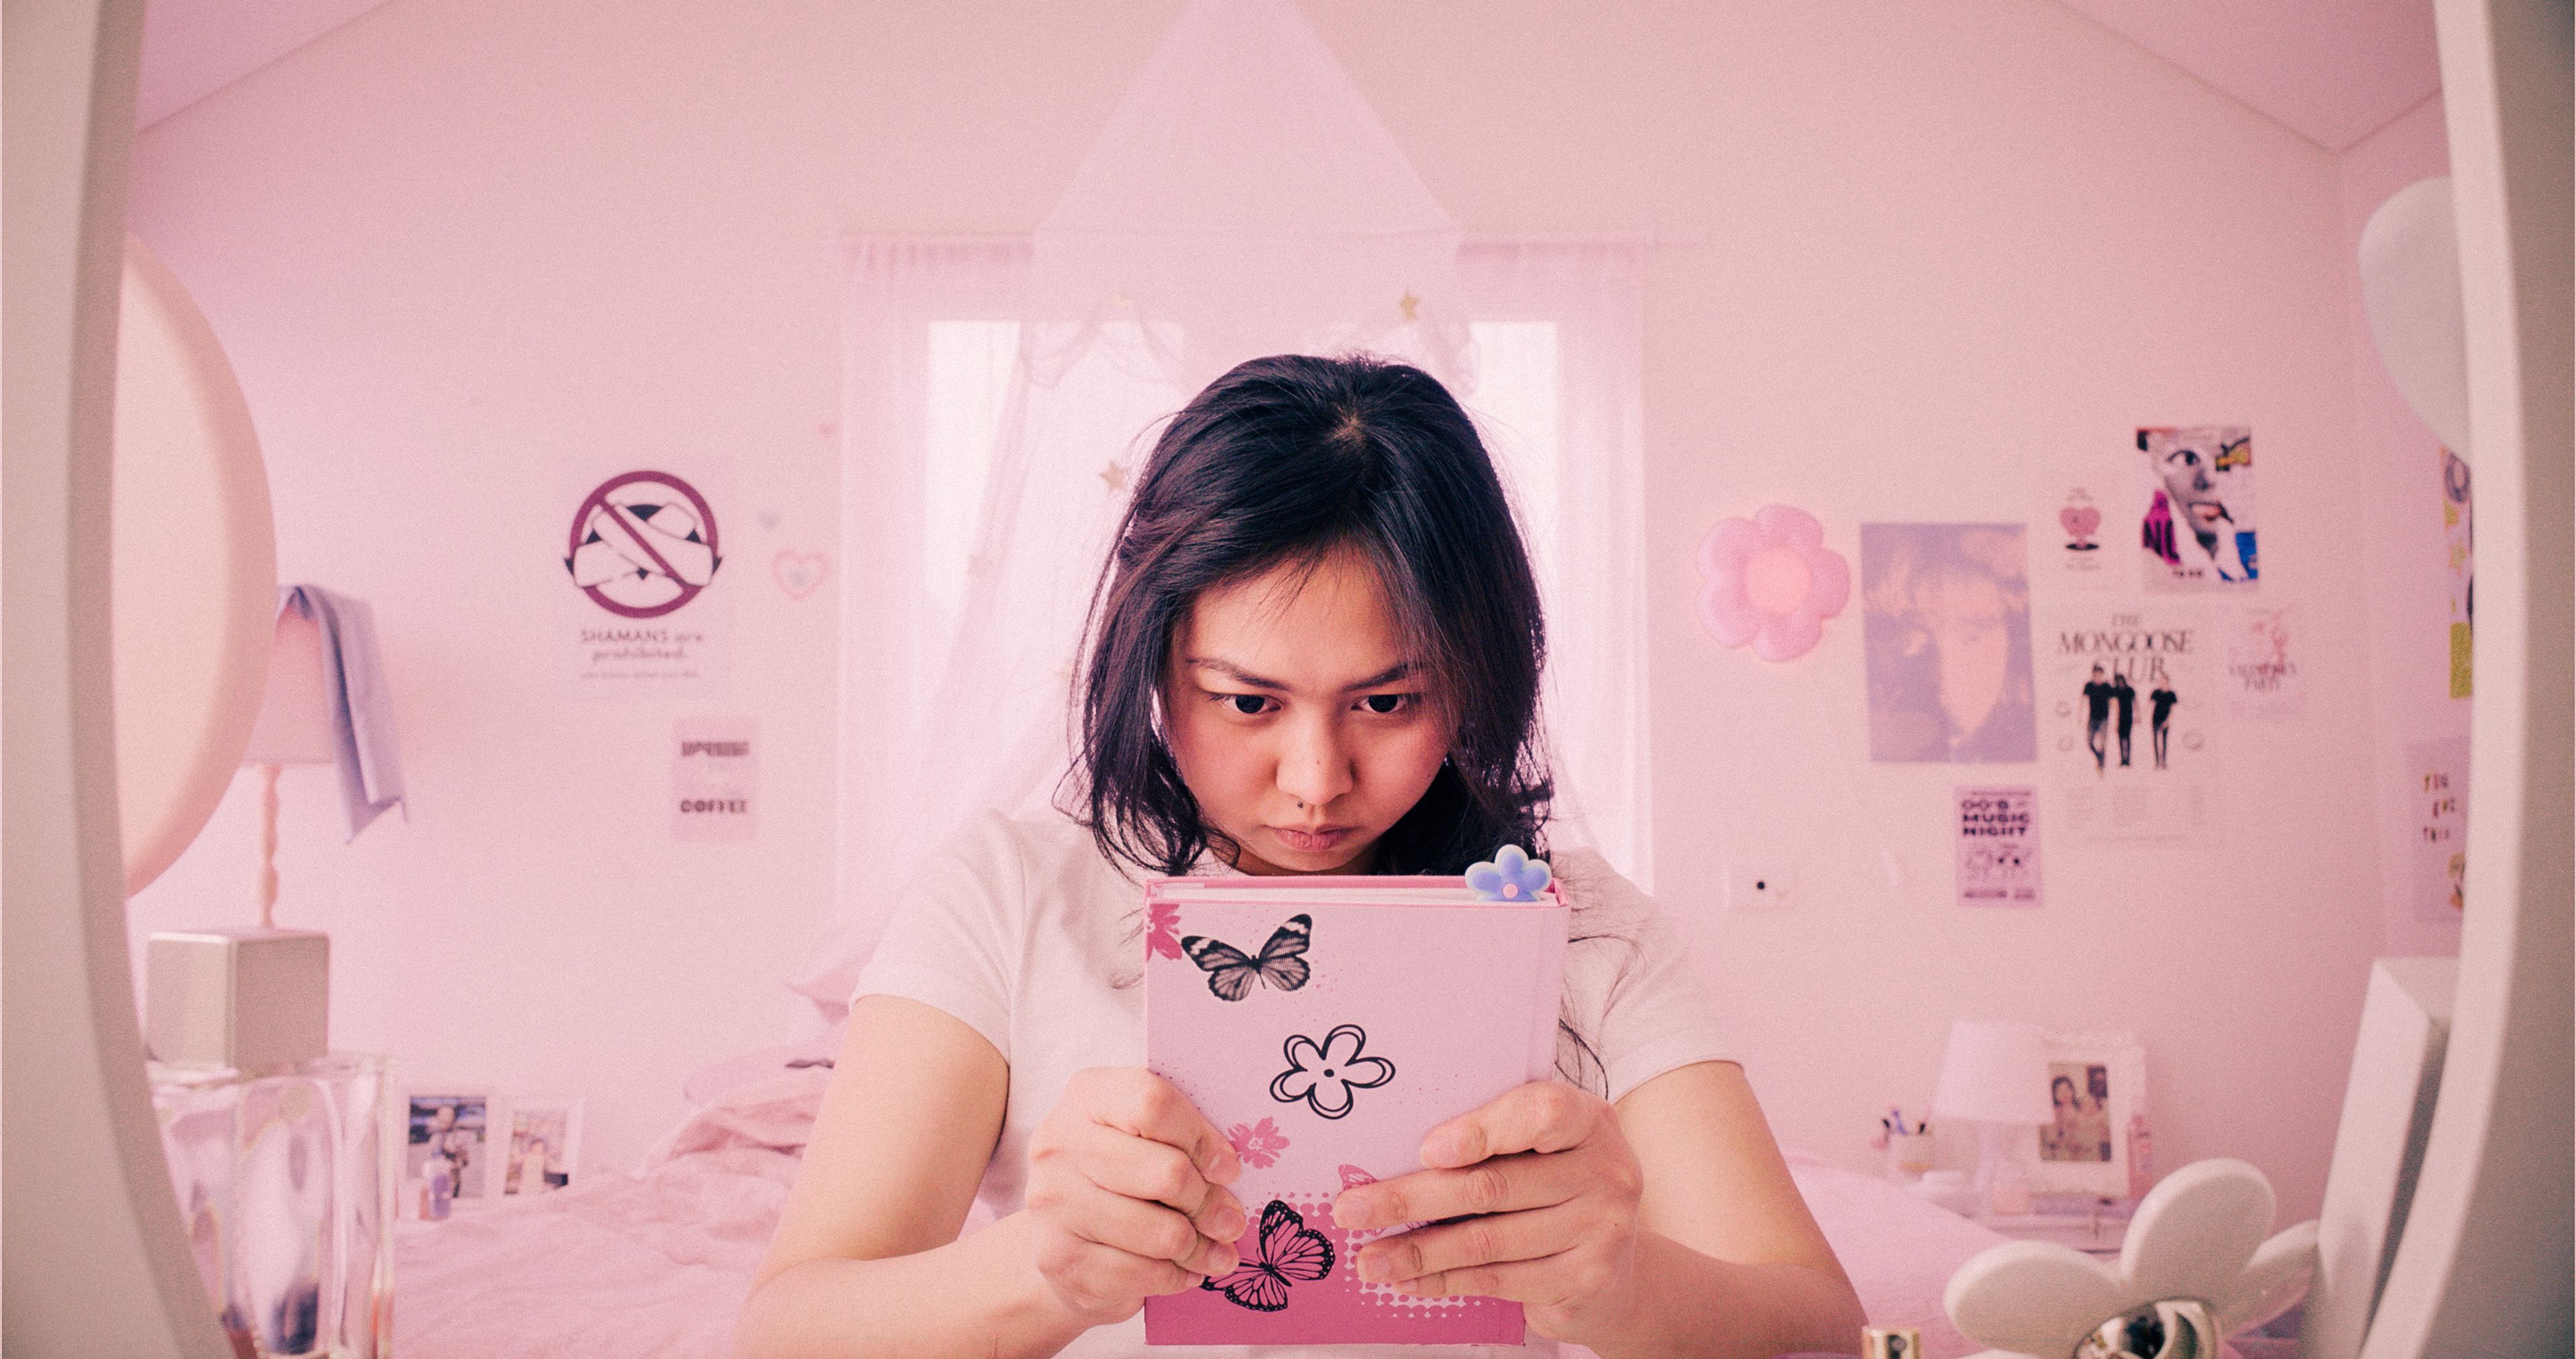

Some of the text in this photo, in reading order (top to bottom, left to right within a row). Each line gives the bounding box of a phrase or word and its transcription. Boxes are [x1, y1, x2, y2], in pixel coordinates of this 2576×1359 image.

[581, 629, 703, 642] SHAMANS are
[2056, 631, 2194, 654] MONGOOSE
[680, 799, 748, 813] COFFEE
[1962, 812, 2031, 824] MUSIC
[1962, 826, 2027, 836] NIGHT
